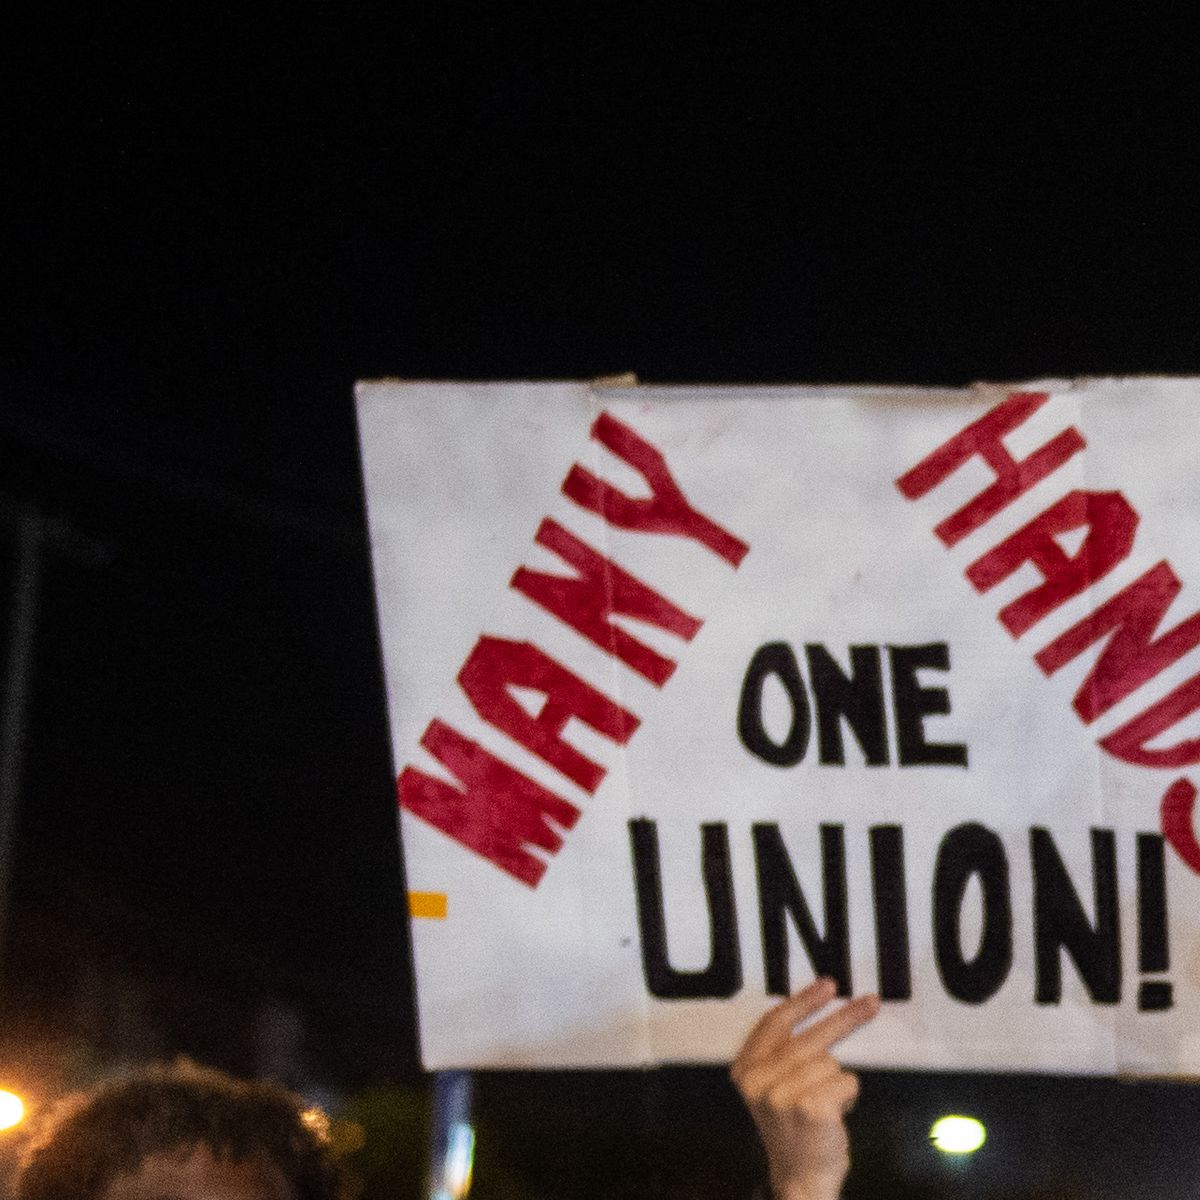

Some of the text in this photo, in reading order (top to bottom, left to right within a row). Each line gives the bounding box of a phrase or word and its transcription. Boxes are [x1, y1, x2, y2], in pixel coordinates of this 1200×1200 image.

[398, 410, 751, 891] MANY
[737, 640, 970, 770] ONE
[627, 814, 1175, 1012] UNION!
